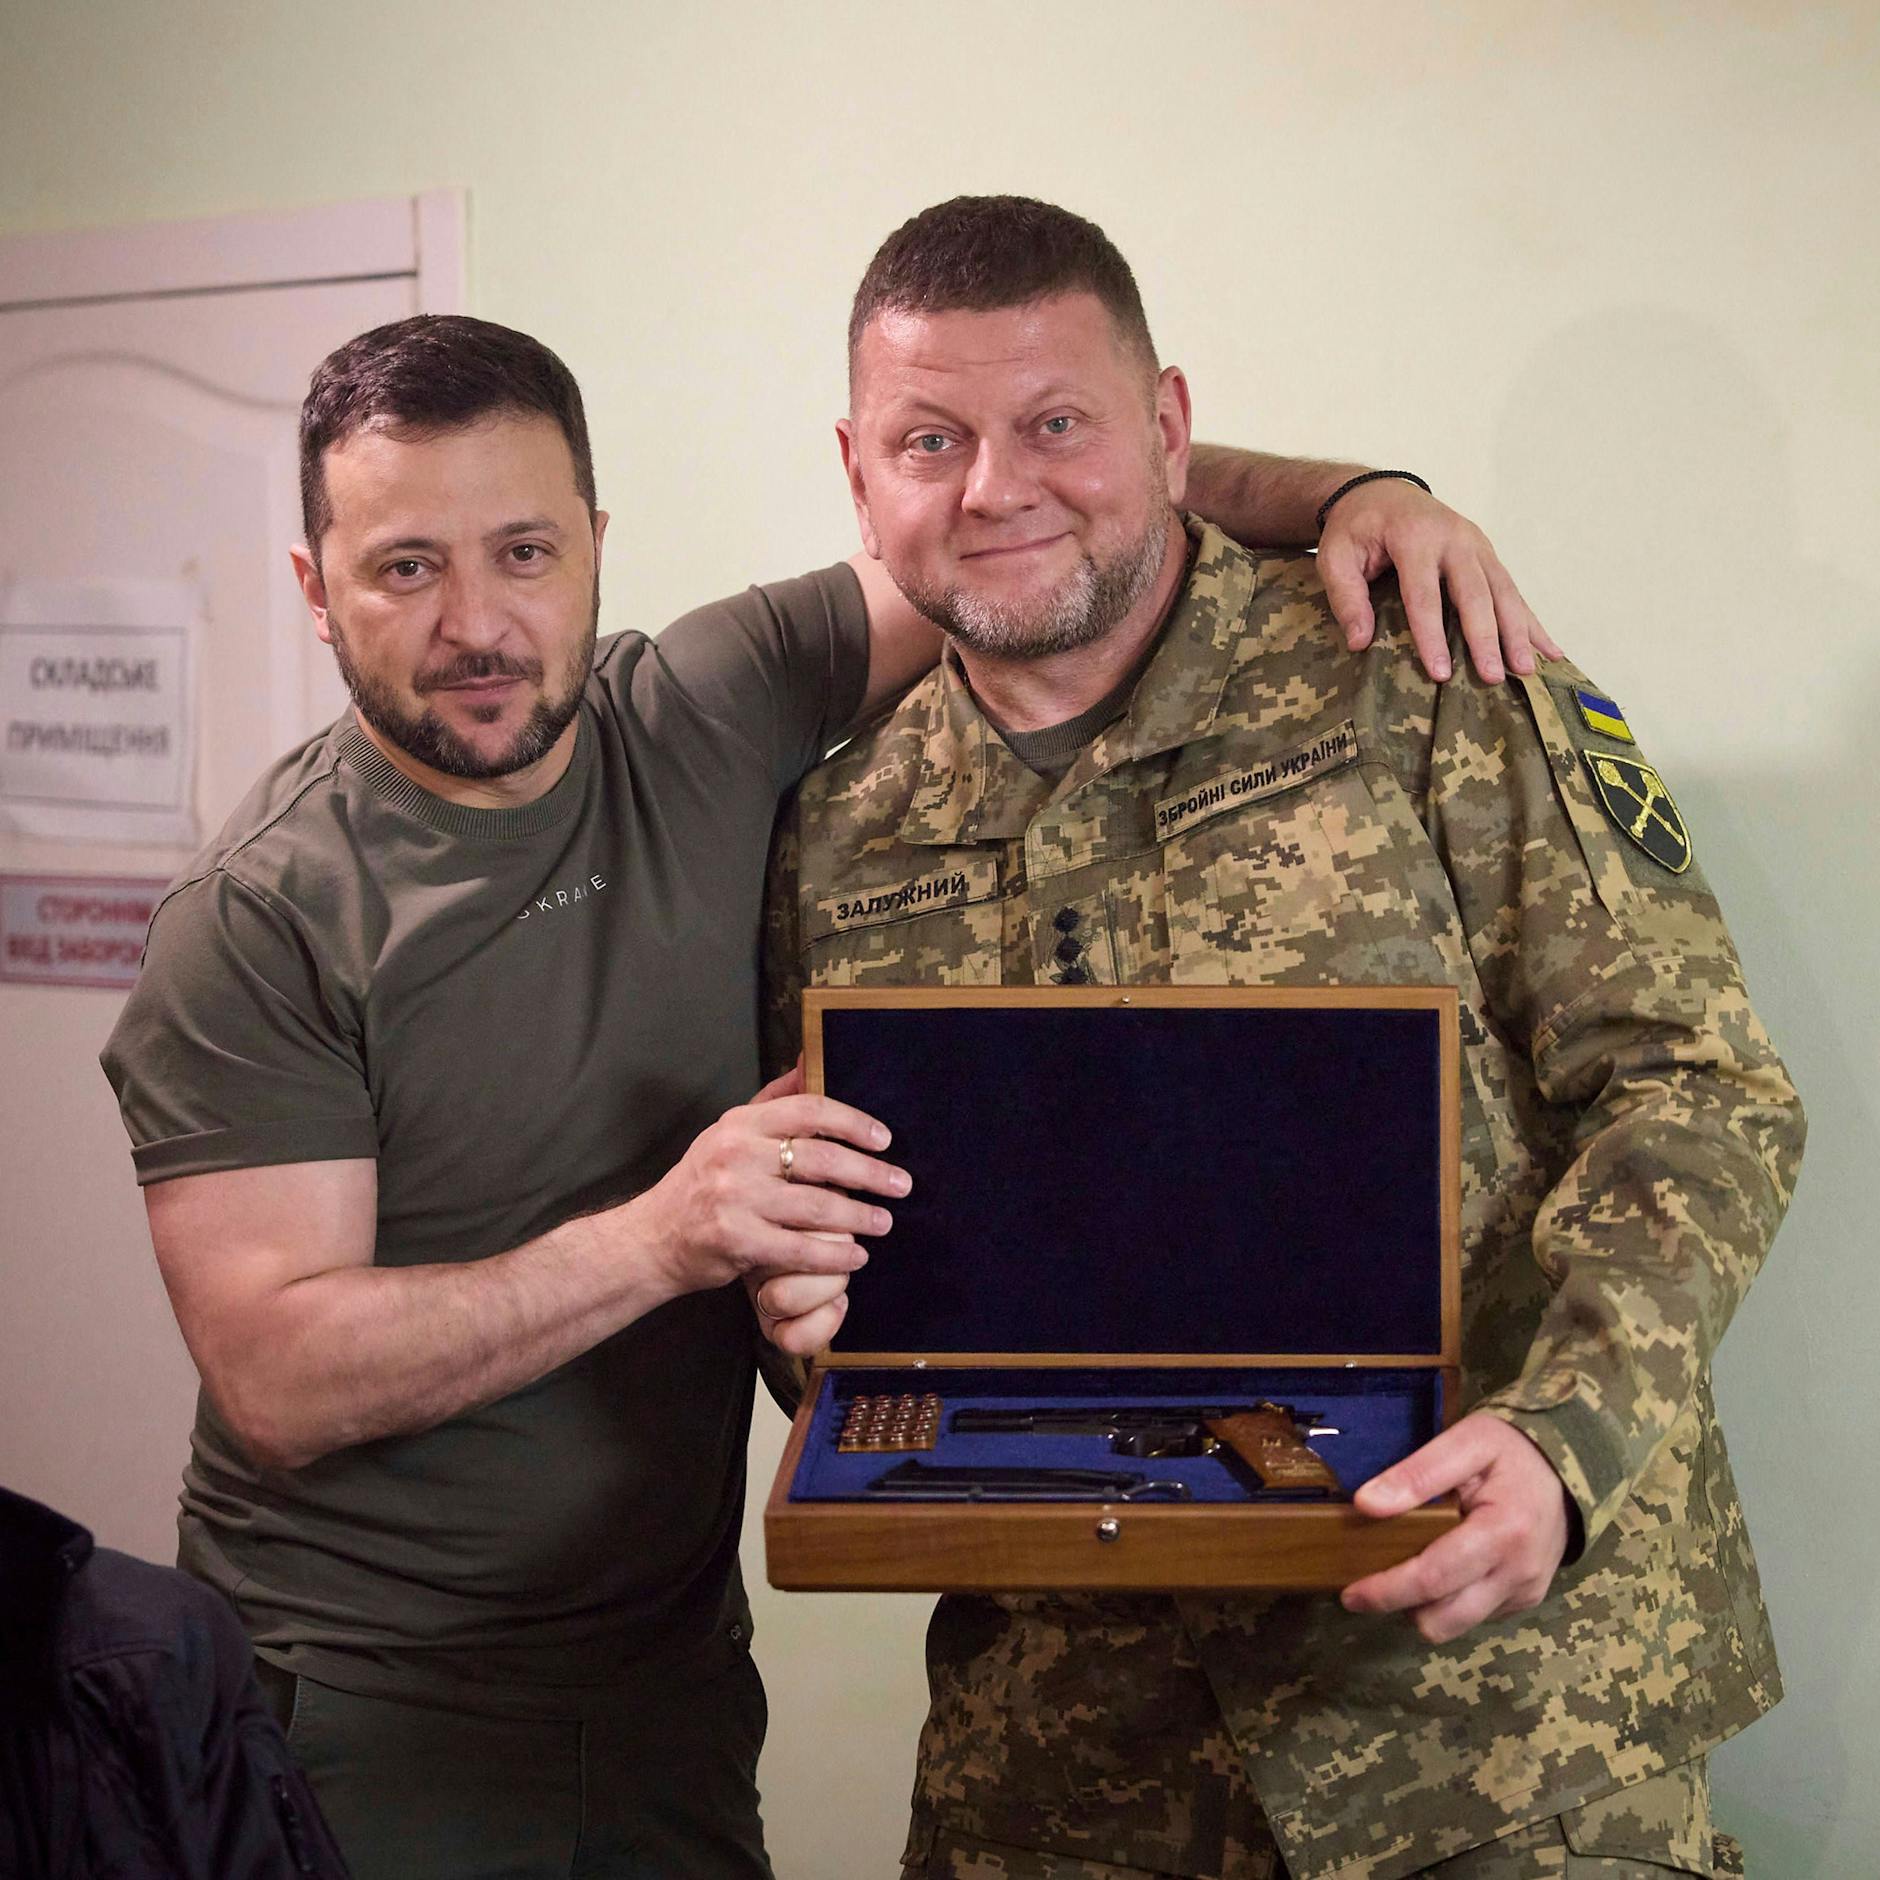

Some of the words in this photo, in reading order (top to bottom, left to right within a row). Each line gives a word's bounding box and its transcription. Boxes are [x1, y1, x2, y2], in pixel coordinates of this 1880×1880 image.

[1158, 784, 1226, 827] ЗБРОЙНІ
[1230, 766, 1277, 795] СИЛИ
[1281, 732, 1348, 778] УКРАЇНИ
[837, 871, 966, 921] ЗАЛУЖНИЙ
